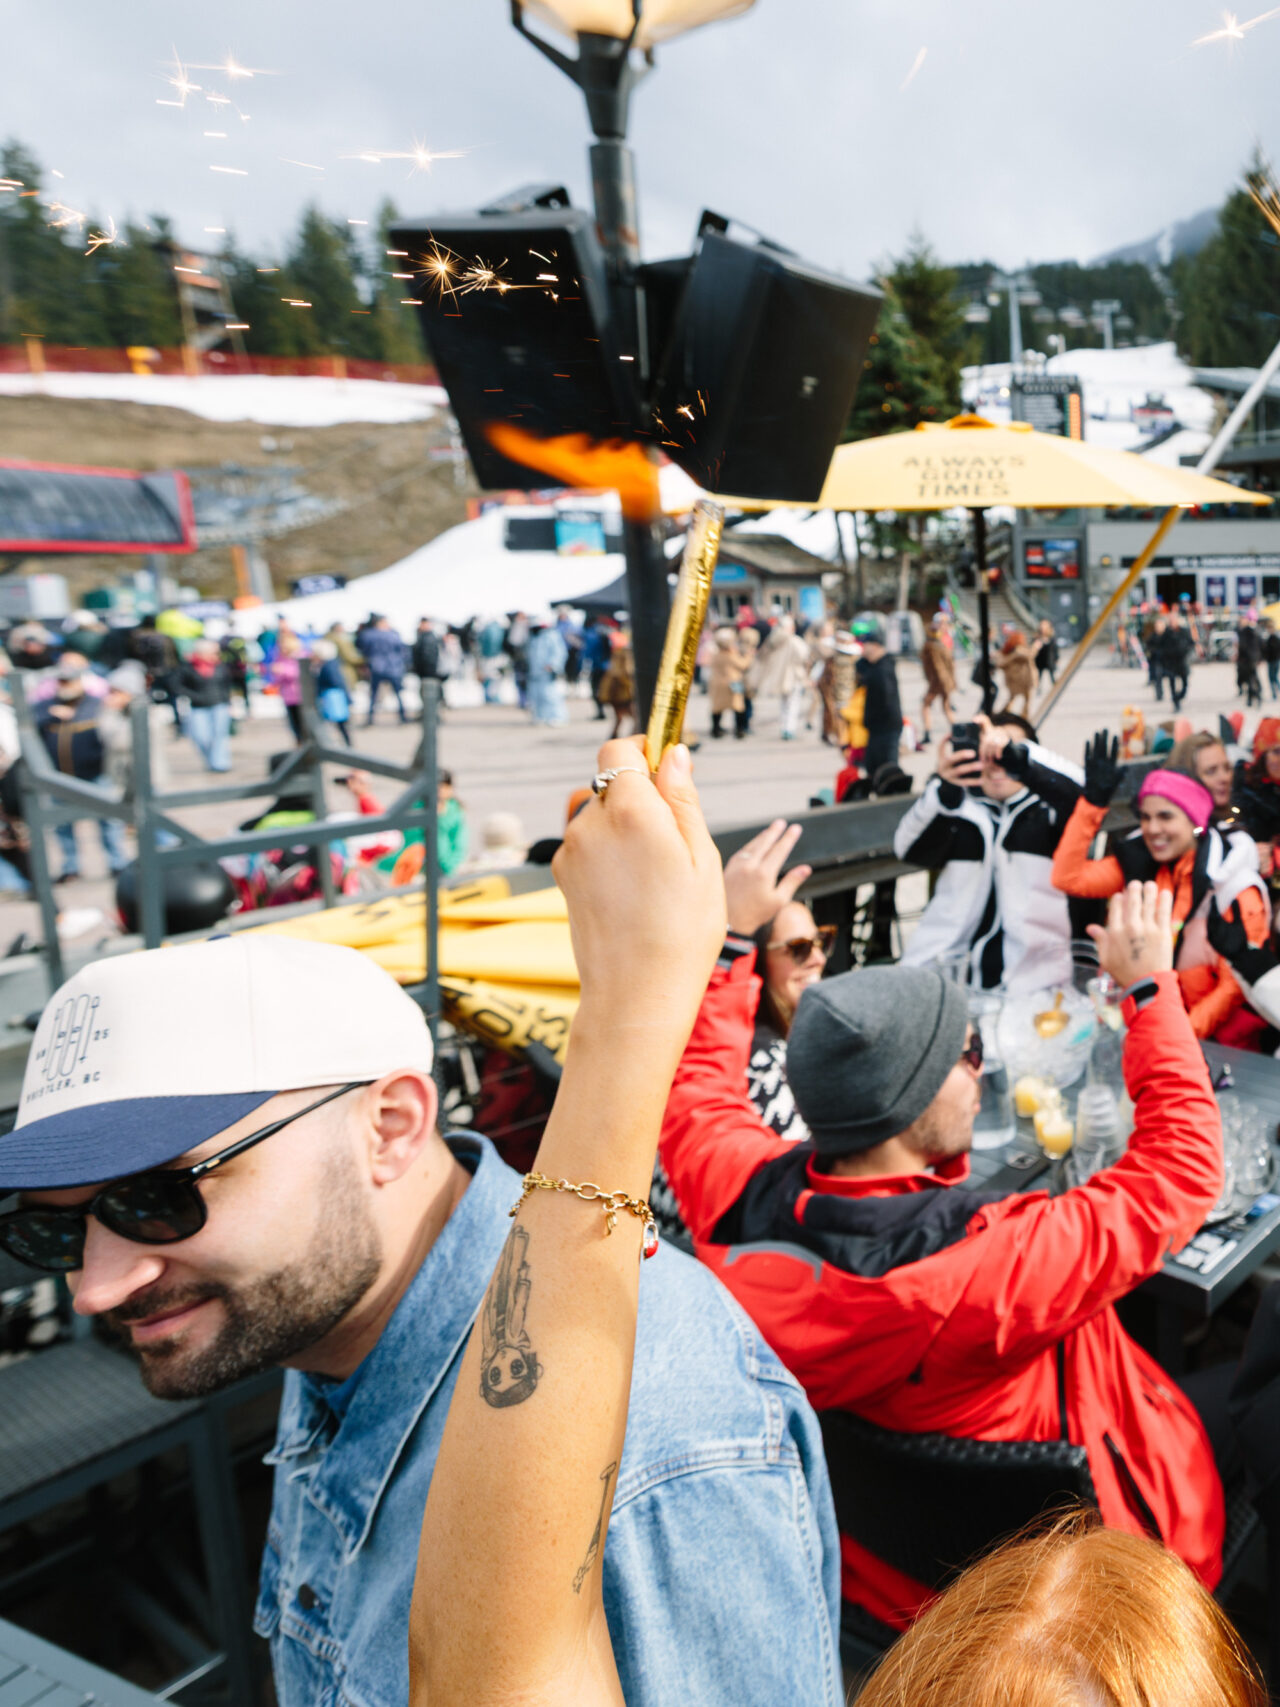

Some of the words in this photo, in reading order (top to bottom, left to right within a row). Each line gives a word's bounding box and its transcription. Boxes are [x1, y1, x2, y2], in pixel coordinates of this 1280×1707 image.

[903, 456, 1025, 466] ALWAYS
[921, 469, 1005, 480] GOOD
[918, 484, 1009, 496] TIMES
[94, 1029, 109, 1041] 25
[83, 1071, 101, 1084] BC
